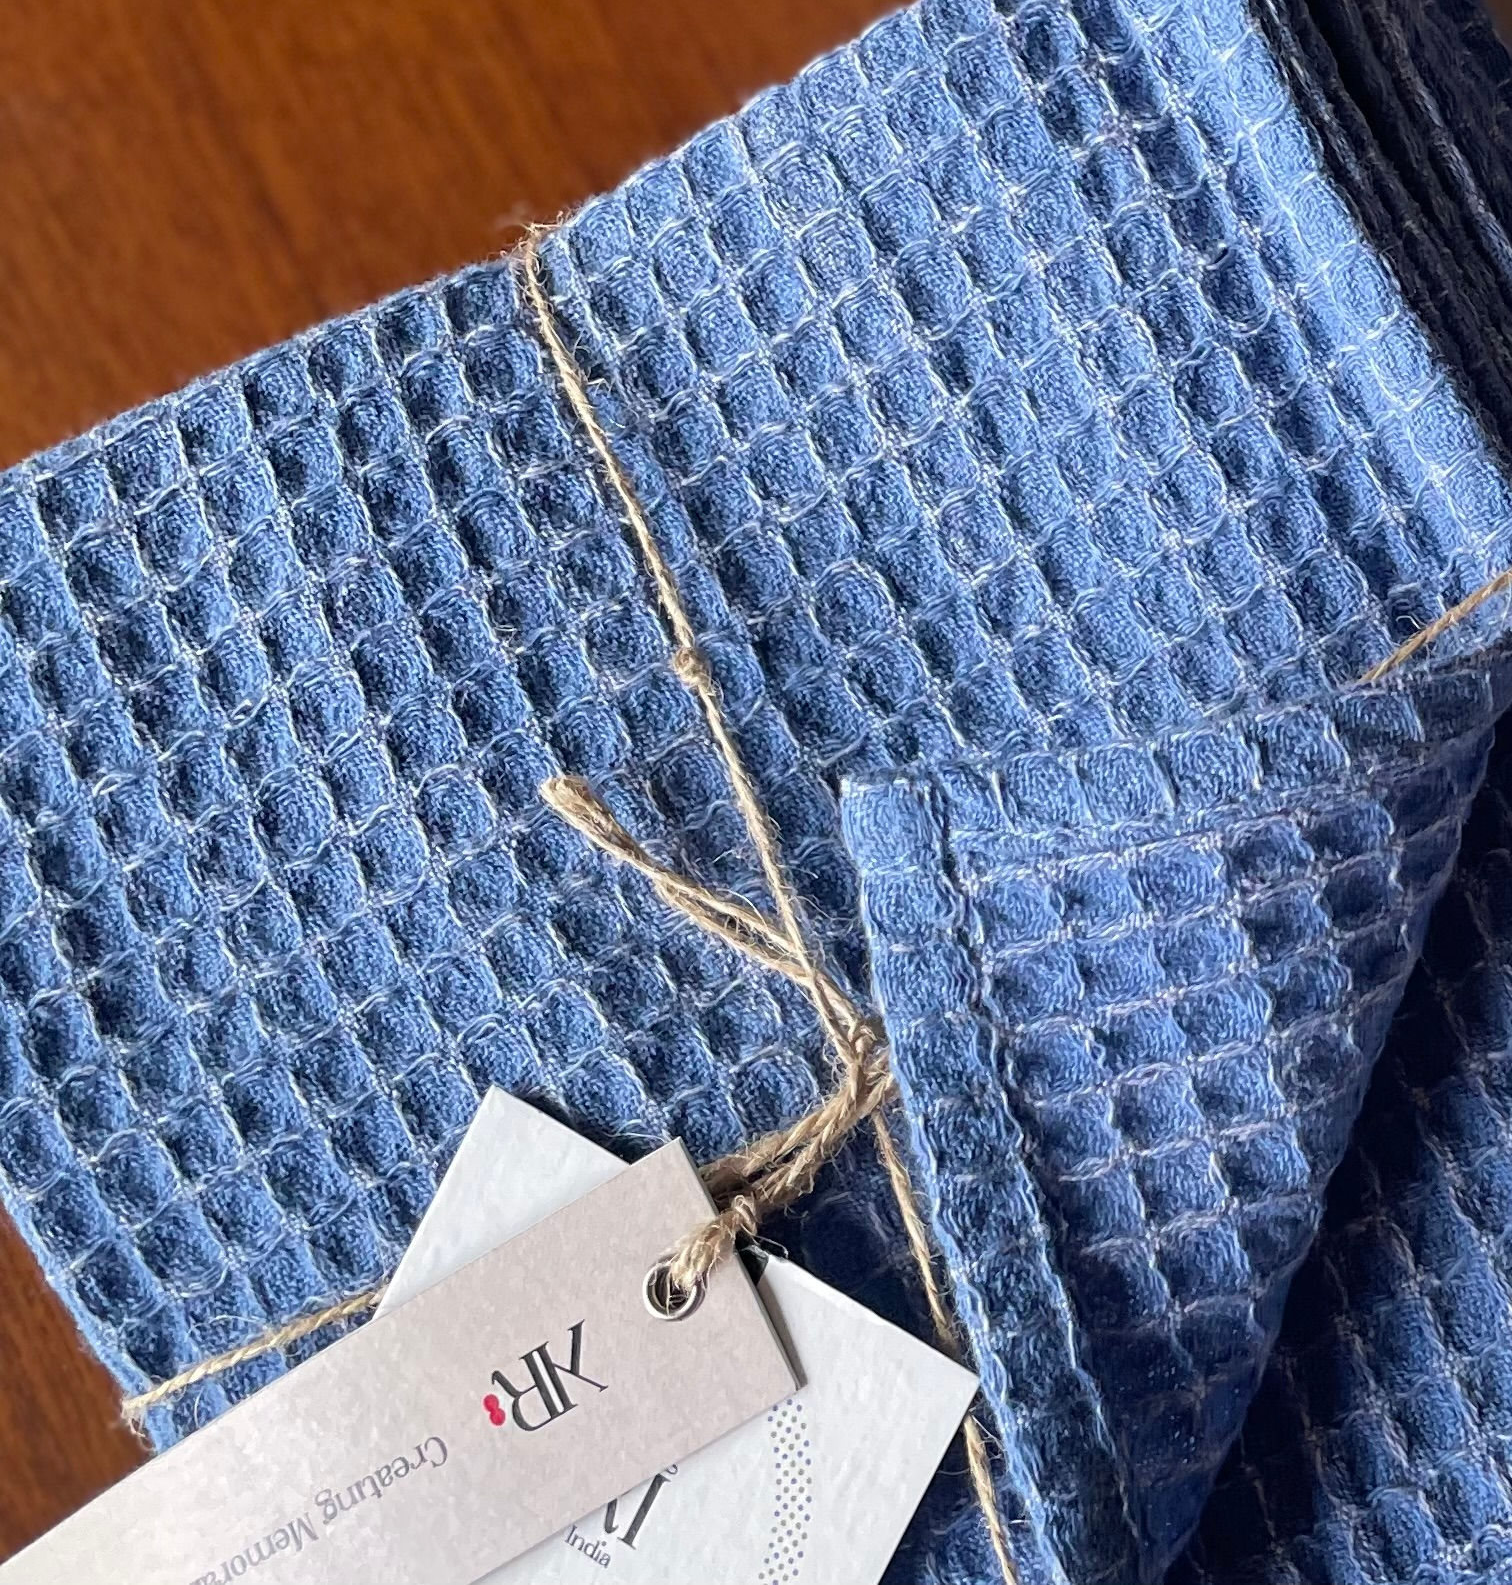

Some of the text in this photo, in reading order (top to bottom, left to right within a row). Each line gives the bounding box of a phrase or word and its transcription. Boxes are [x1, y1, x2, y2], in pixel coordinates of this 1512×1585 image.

[189, 1436, 448, 1585] Creating Memora
[564, 1525, 612, 1569] India
